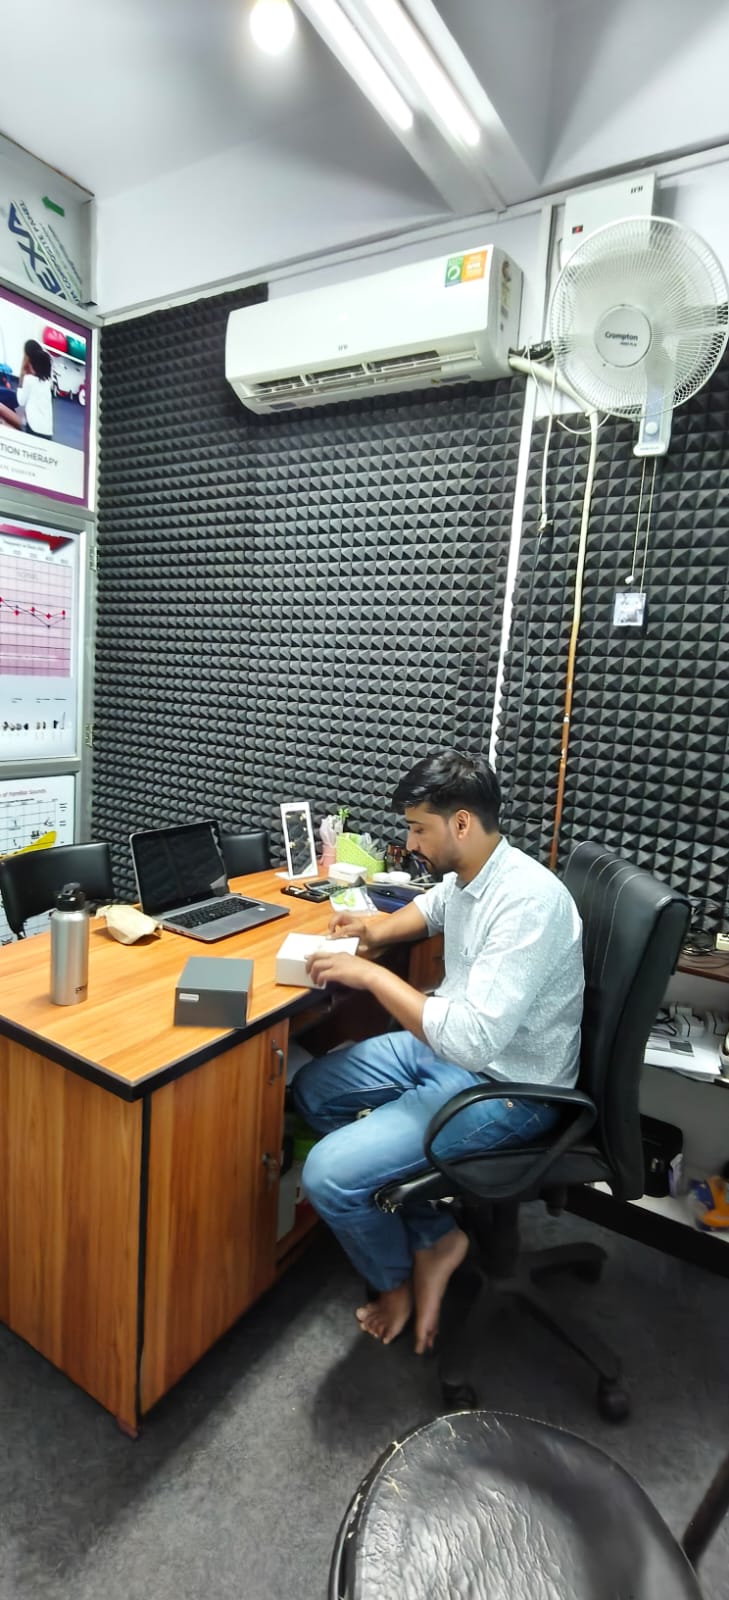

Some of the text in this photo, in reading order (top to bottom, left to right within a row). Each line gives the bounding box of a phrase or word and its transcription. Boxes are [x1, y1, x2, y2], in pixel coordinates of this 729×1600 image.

[19, 199, 40, 233] PANEL
[8, 202, 66, 300] EXA
[604, 331, 639, 341] Crompton
[22, 449, 59, 466] THERAPY
